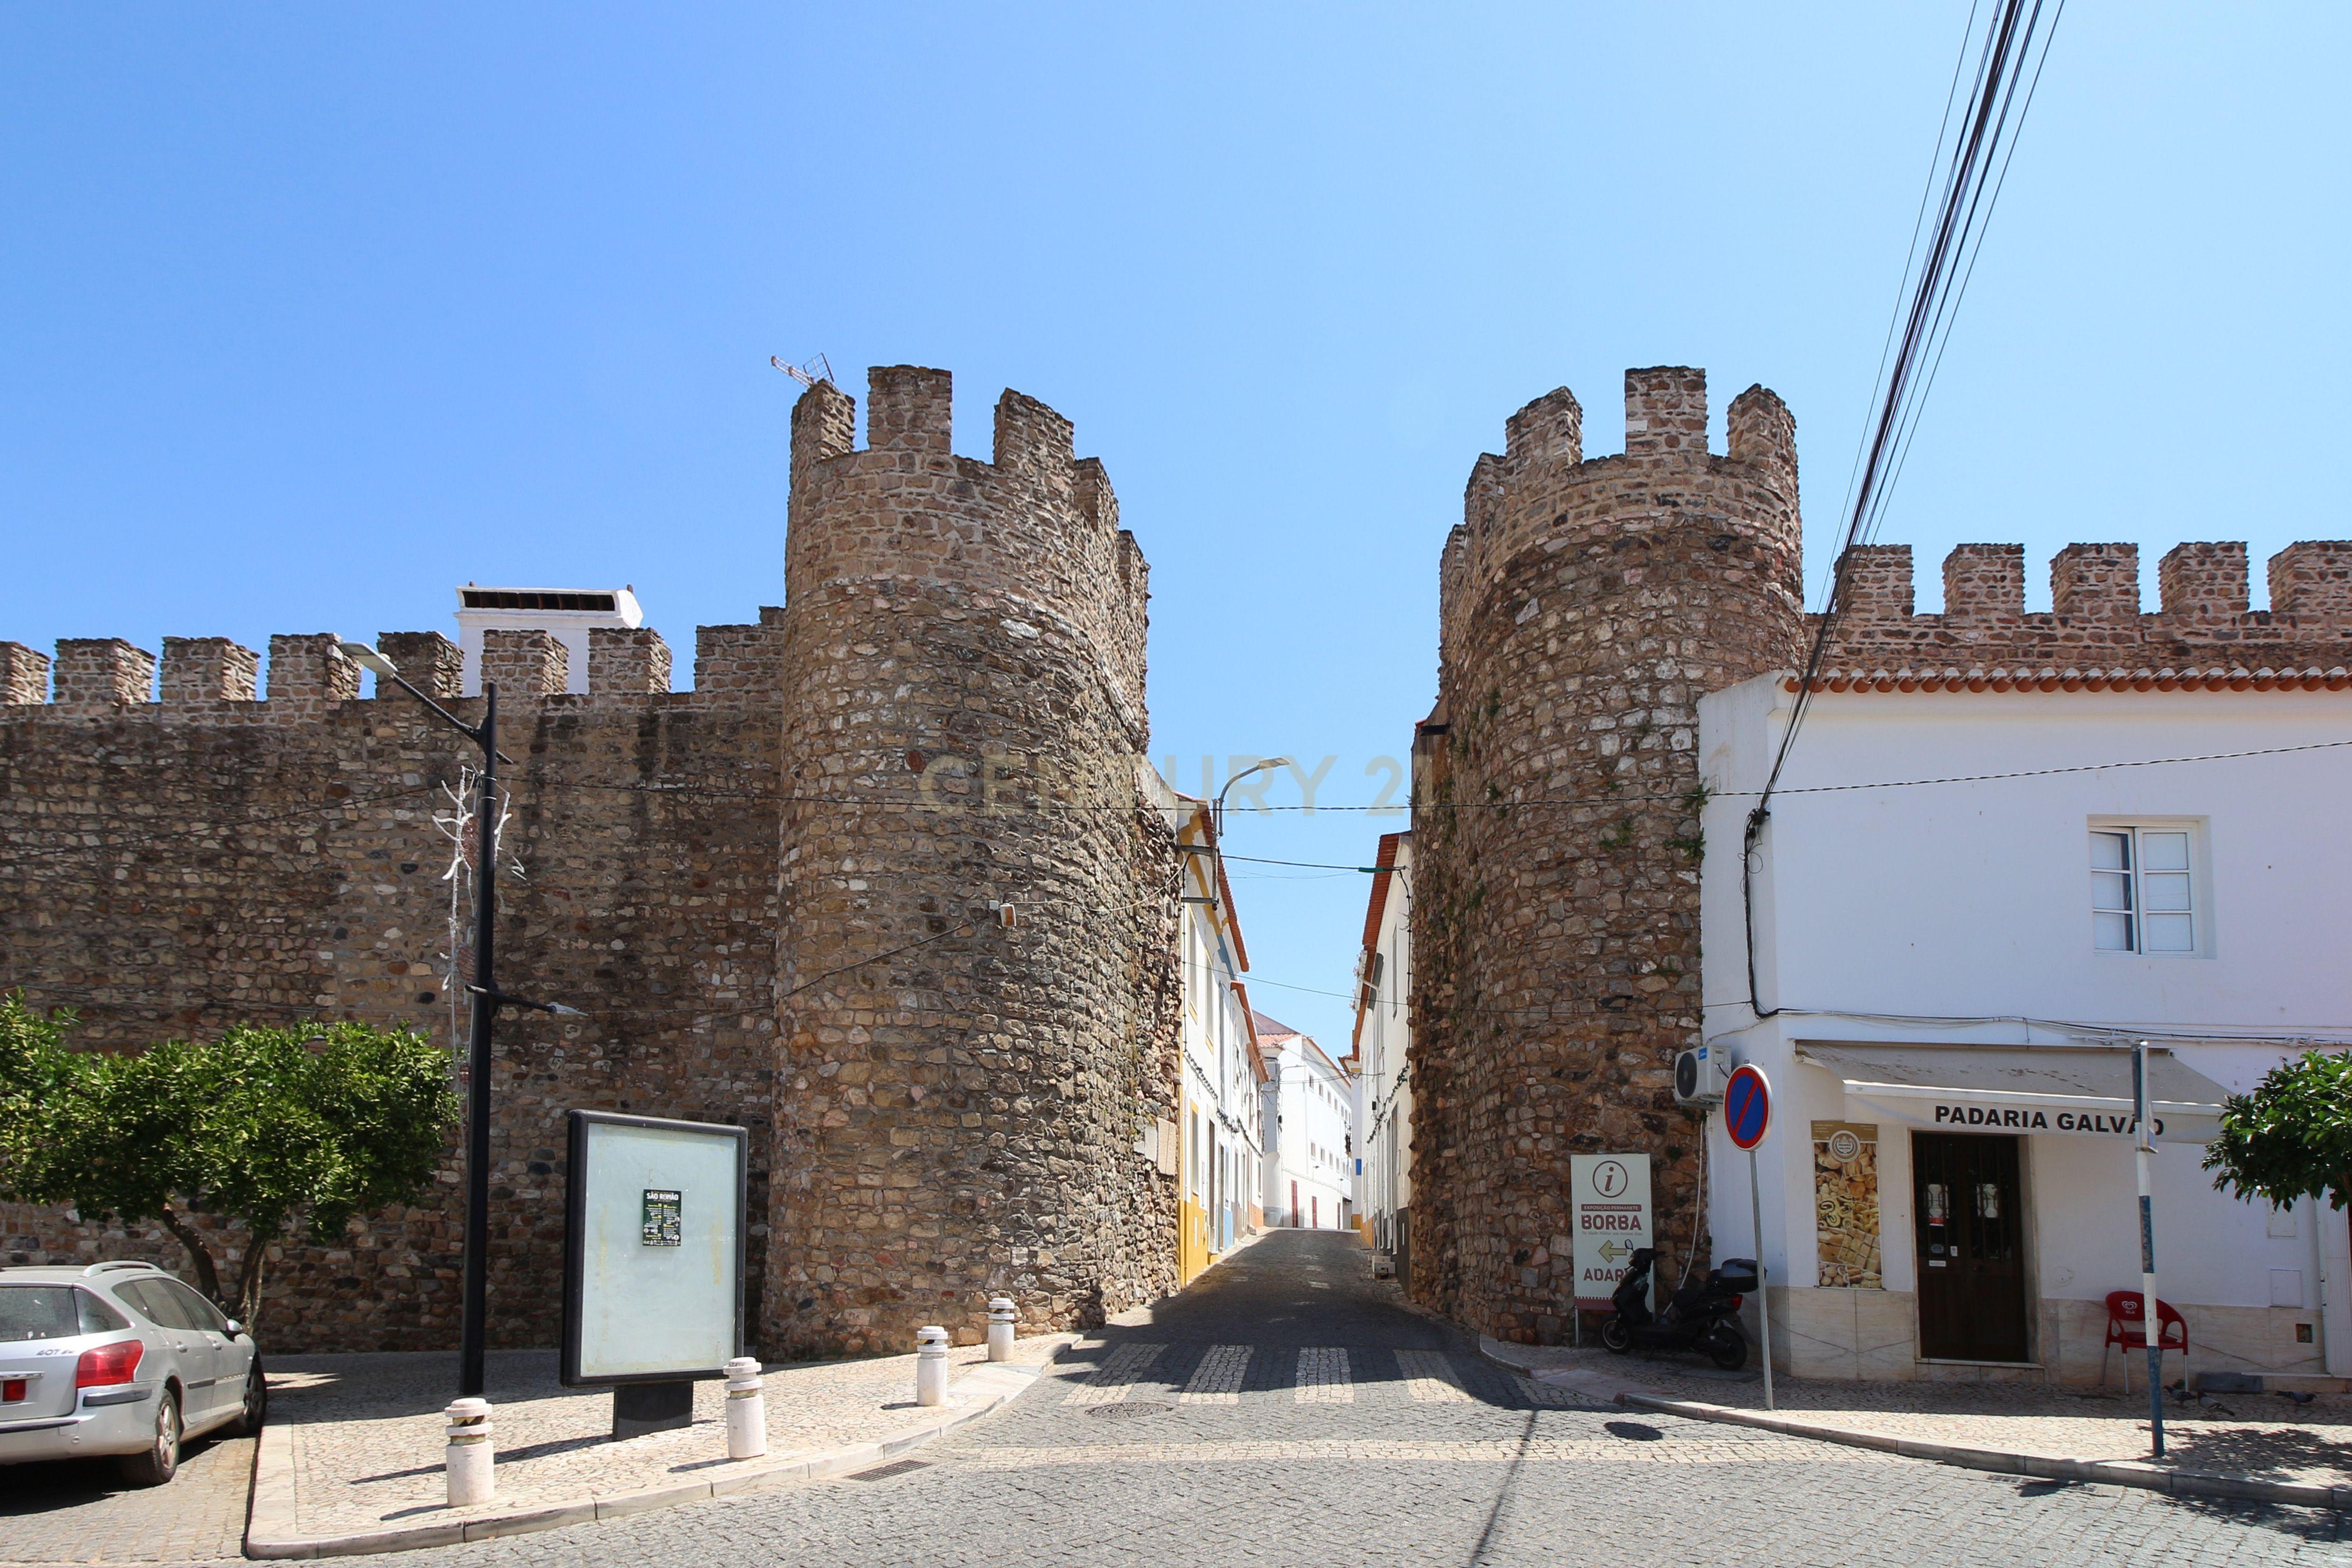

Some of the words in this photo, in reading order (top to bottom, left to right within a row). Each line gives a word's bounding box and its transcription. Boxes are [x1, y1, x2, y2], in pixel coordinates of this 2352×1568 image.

[1935, 1105, 2048, 1129] PADARIA
[647, 1191, 658, 1200] SÃO
[659, 1193, 679, 1201] ROMÃO
[1582, 1214, 1642, 1230] BORBA
[1583, 1268, 1624, 1282] ADAR
